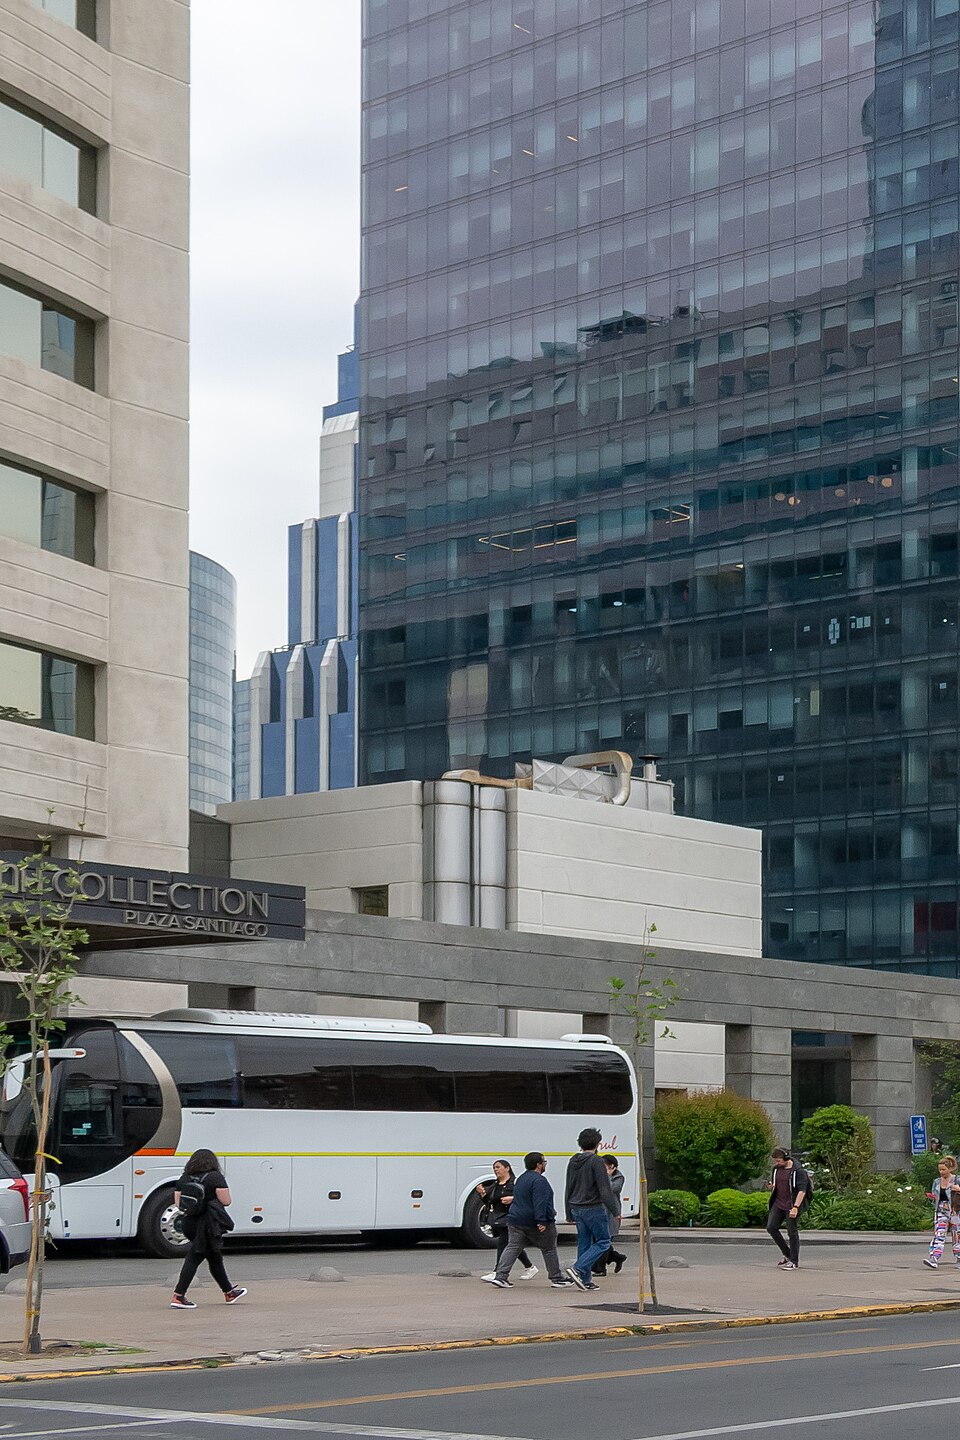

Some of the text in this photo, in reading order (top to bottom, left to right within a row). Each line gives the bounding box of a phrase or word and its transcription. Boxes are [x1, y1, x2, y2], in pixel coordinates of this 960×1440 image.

[52, 868, 270, 919] COLLECTION
[124, 910, 269, 938] PLAZA SANTIAGO
